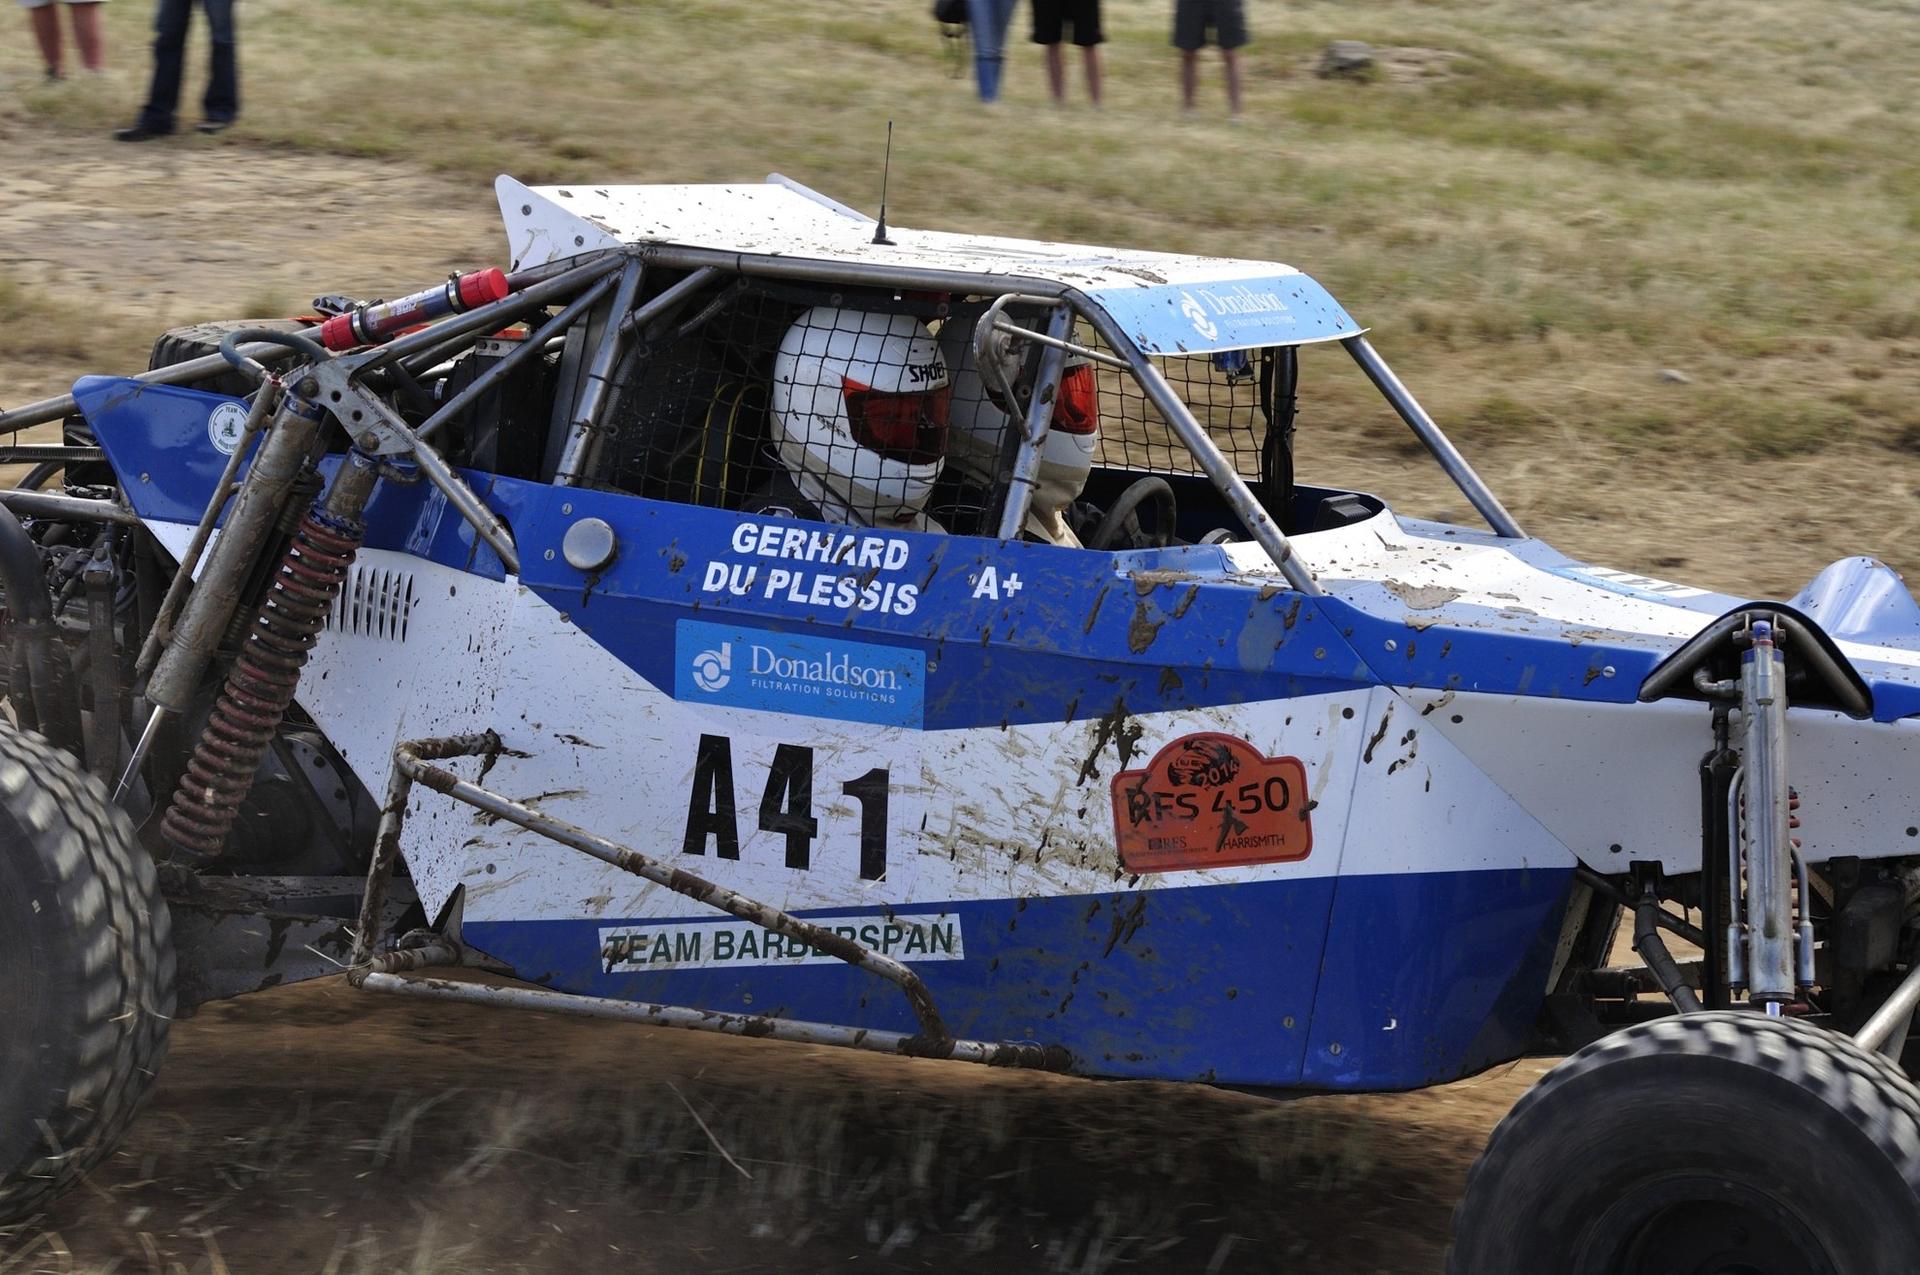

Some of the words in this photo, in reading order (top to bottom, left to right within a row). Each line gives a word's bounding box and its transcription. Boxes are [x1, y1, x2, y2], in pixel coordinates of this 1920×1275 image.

[732, 522, 909, 571] GERHARD
[702, 561, 757, 596] DU
[764, 568, 919, 616] PLESSIS
[972, 566, 1023, 600] A+
[751, 678, 820, 695] FILTRATION
[826, 687, 896, 704] SOLUTIONS
[1200, 760, 1239, 788] 2014
[682, 733, 889, 882] A41
[1125, 788, 1199, 824] RFS
[1212, 776, 1290, 814] 450
[1223, 834, 1285, 850] HARRISMITH
[605, 931, 702, 965] TEAM
